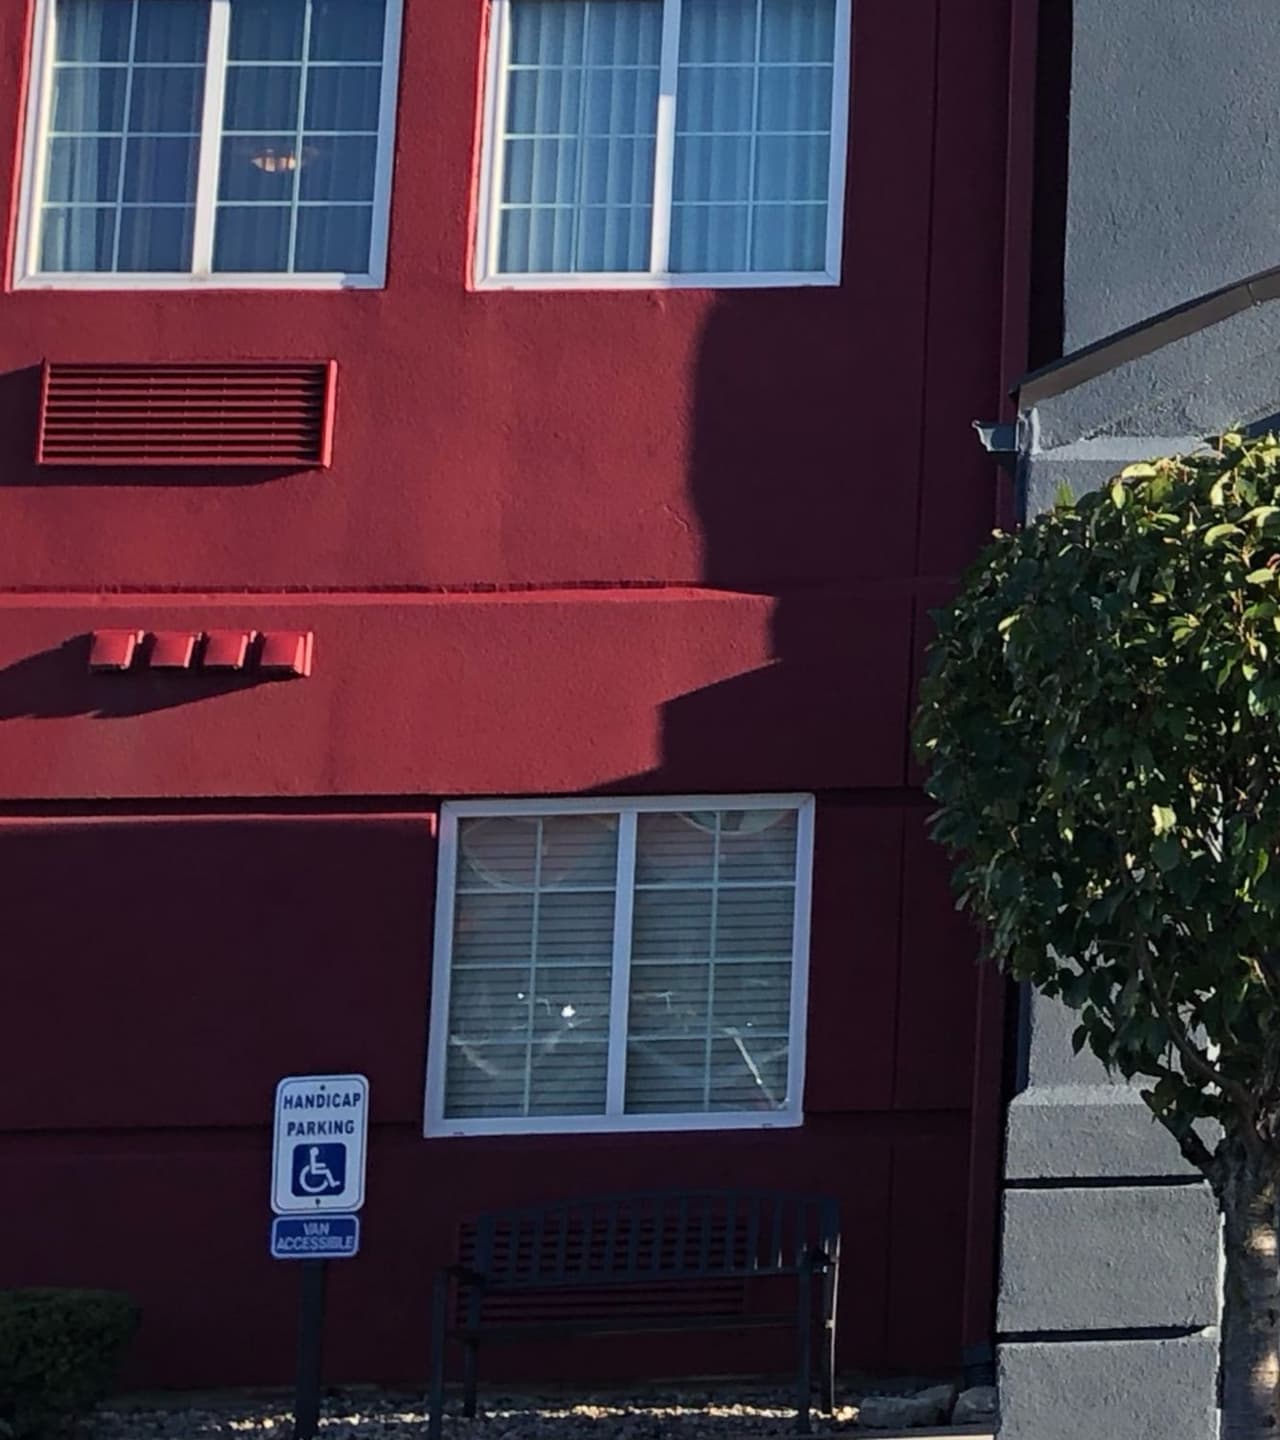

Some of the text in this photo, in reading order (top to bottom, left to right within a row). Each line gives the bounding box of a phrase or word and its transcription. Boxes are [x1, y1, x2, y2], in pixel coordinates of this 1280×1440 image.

[283, 1092, 361, 1109] HANDICAP
[287, 1120, 355, 1136] PARKING
[303, 1222, 330, 1235] VAN
[276, 1236, 354, 1250] ACCESSIBLE
